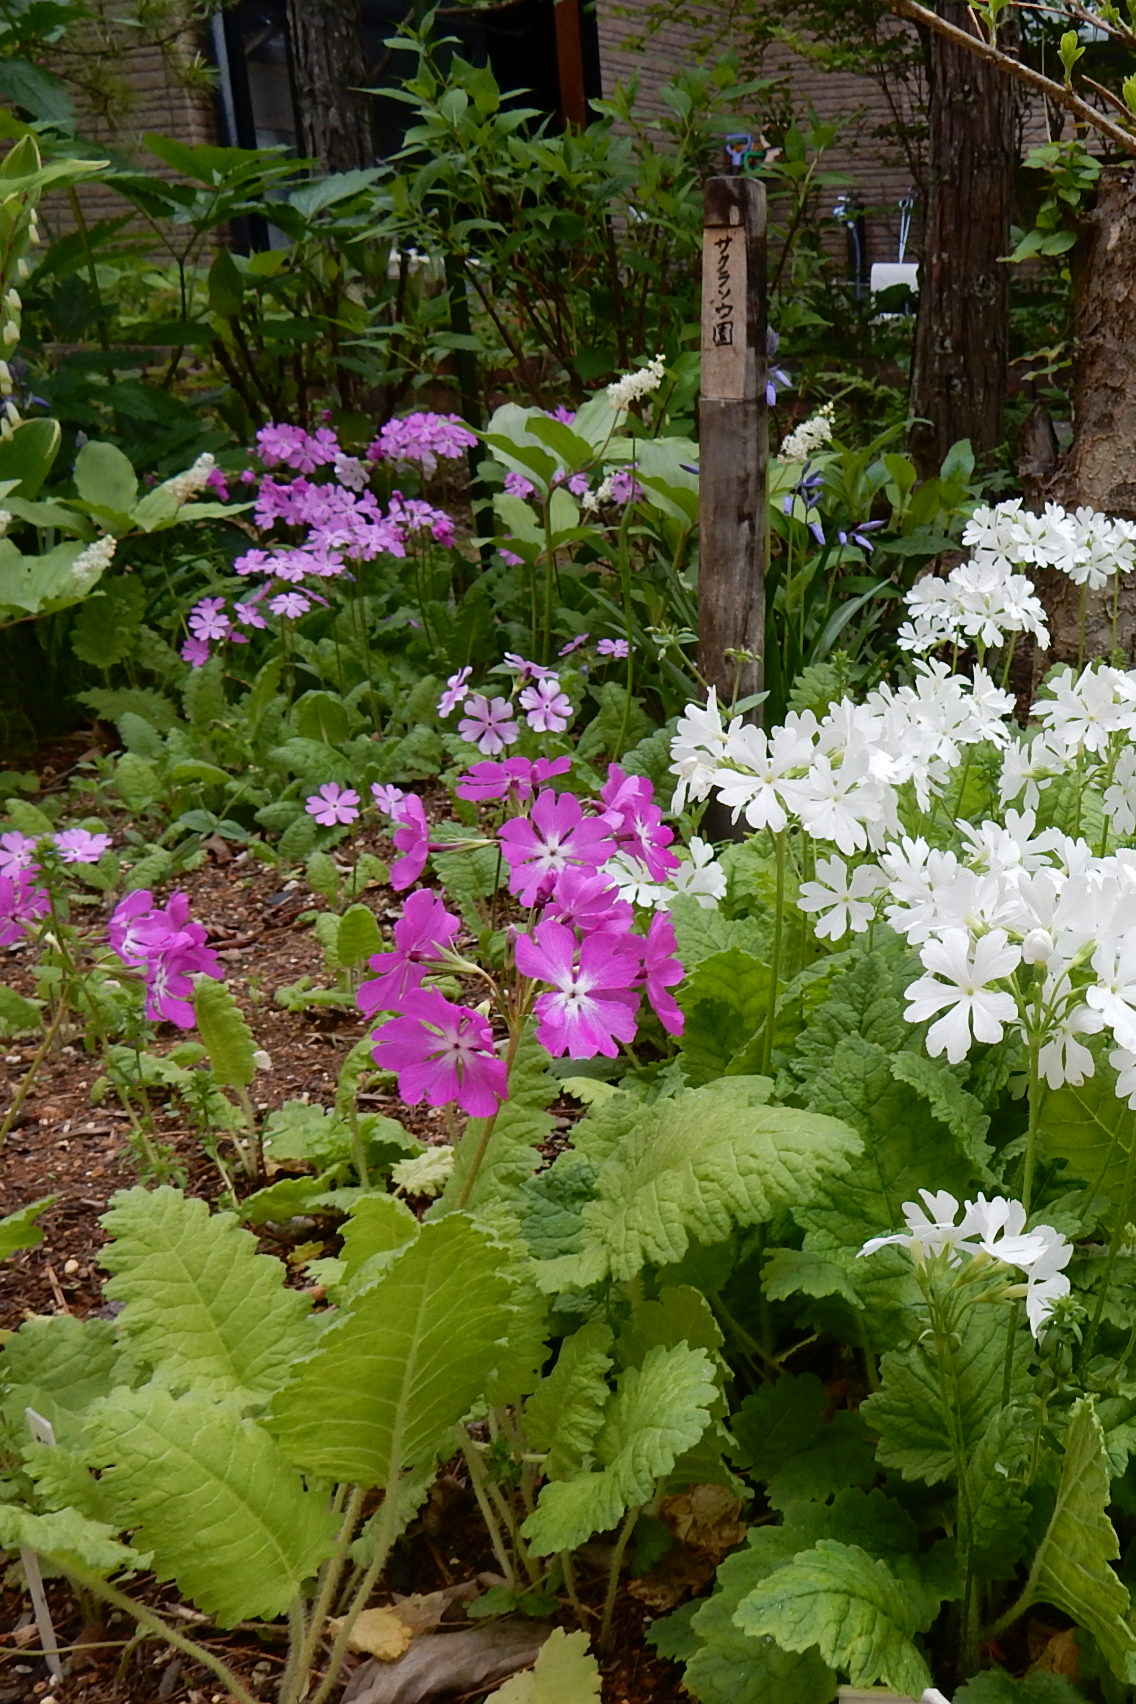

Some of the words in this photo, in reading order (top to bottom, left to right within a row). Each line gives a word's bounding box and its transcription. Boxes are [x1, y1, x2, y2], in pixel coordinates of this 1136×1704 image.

[713, 237, 733, 346] サクラソウ園
